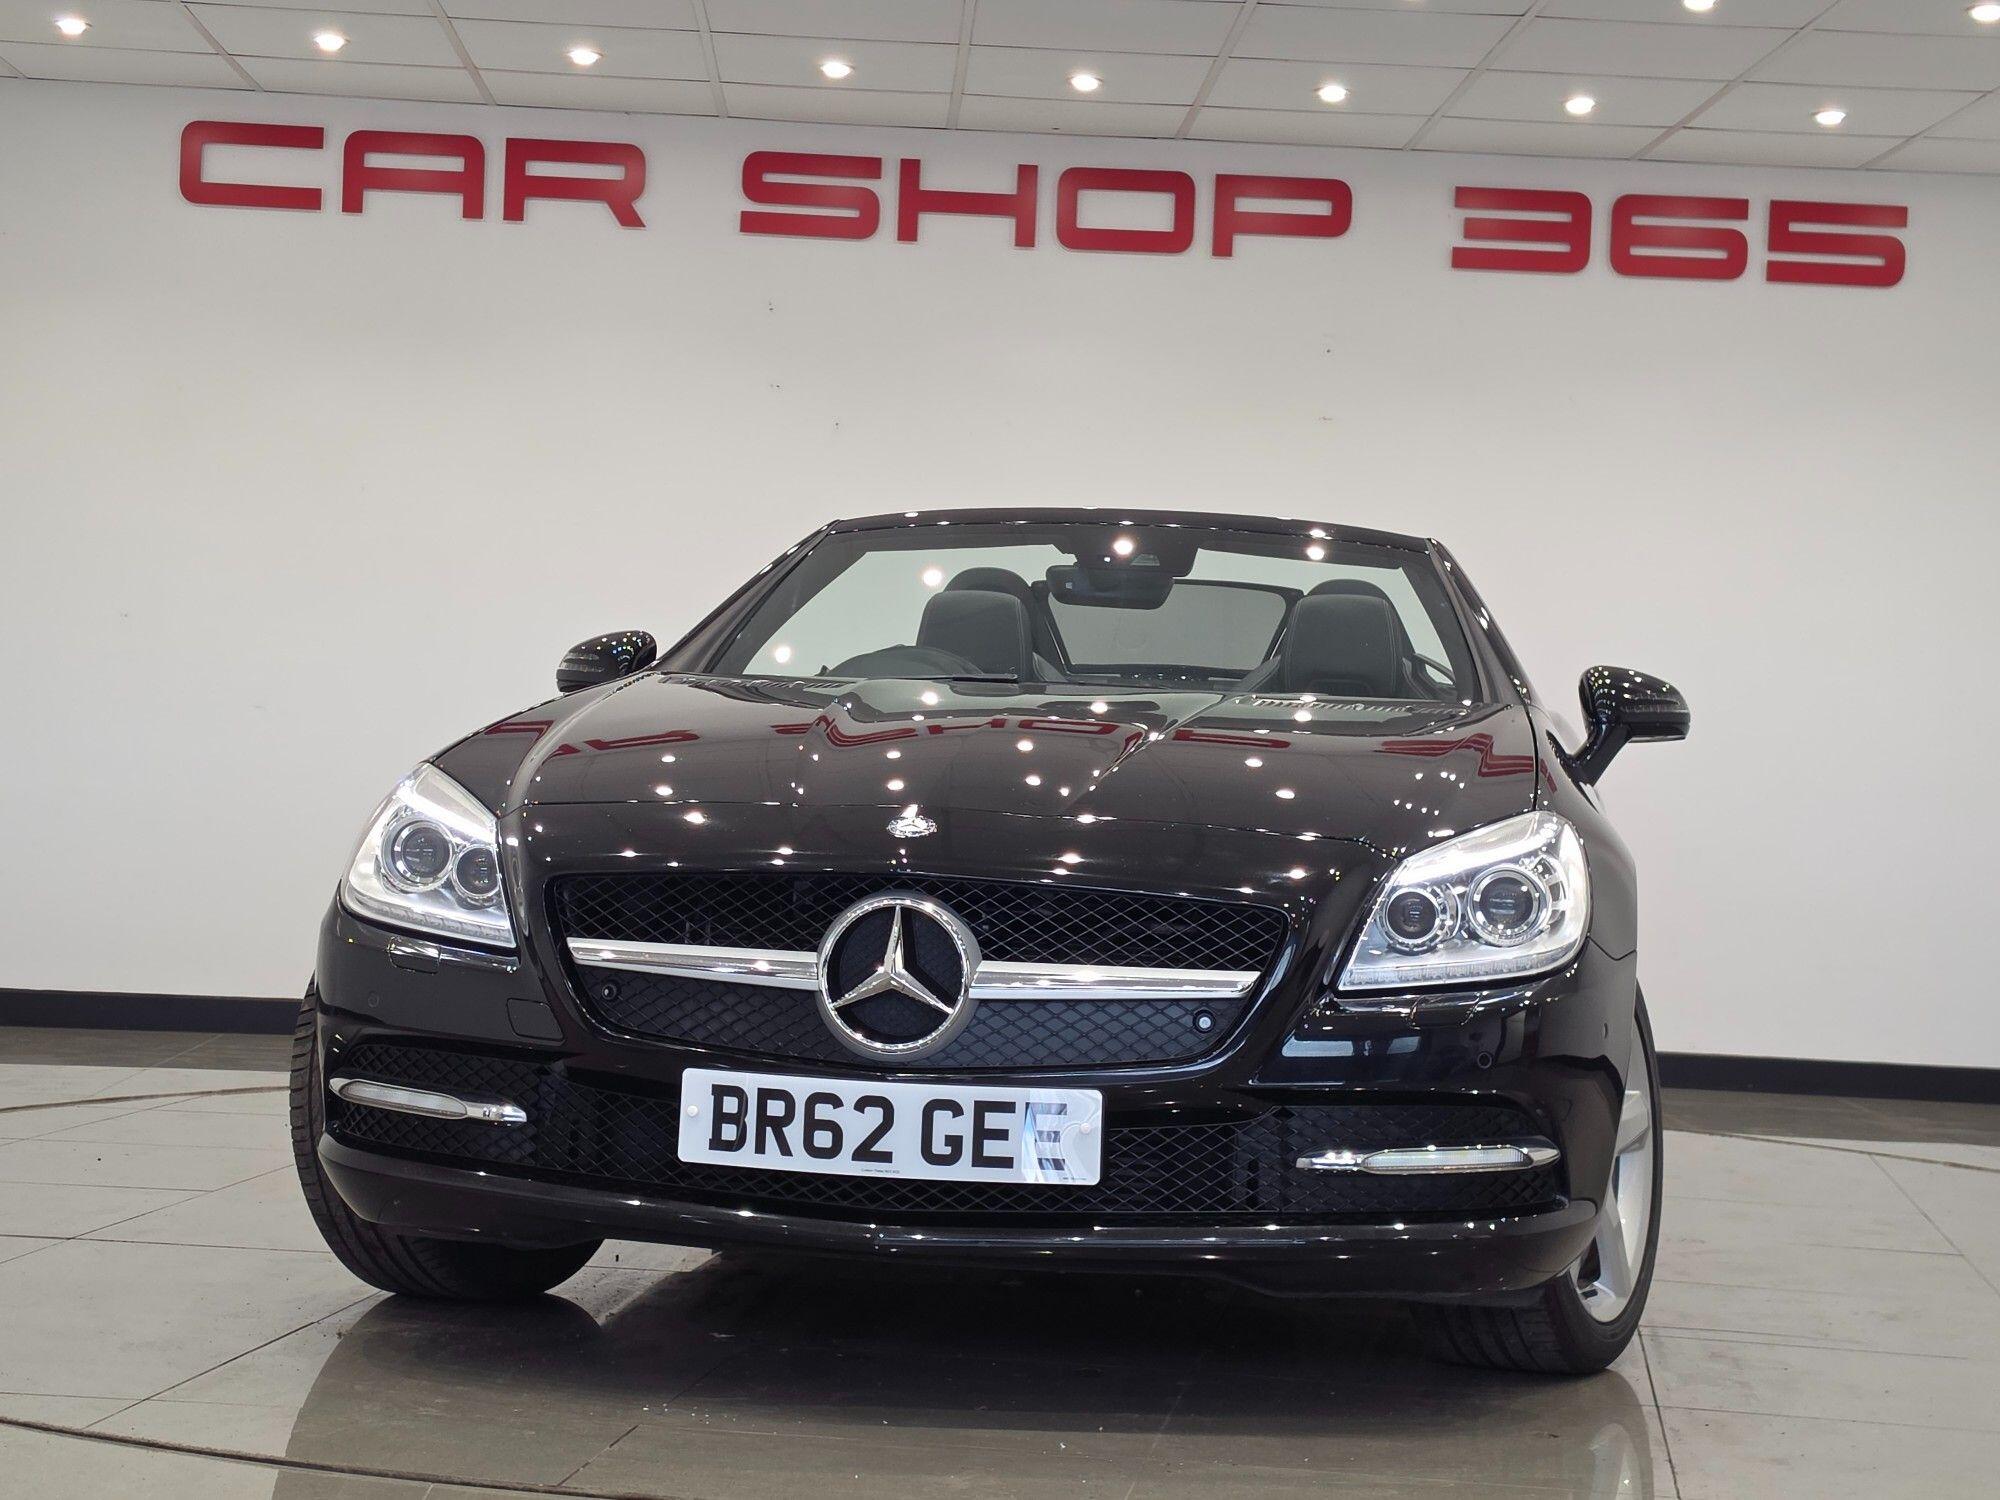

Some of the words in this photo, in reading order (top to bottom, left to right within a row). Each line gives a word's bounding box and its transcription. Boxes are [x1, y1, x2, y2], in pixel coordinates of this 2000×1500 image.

[179, 120, 646, 229] CAR
[739, 151, 1353, 258] SHOP
[1451, 186, 1908, 287] 365
[708, 1083, 896, 1164] BR62
